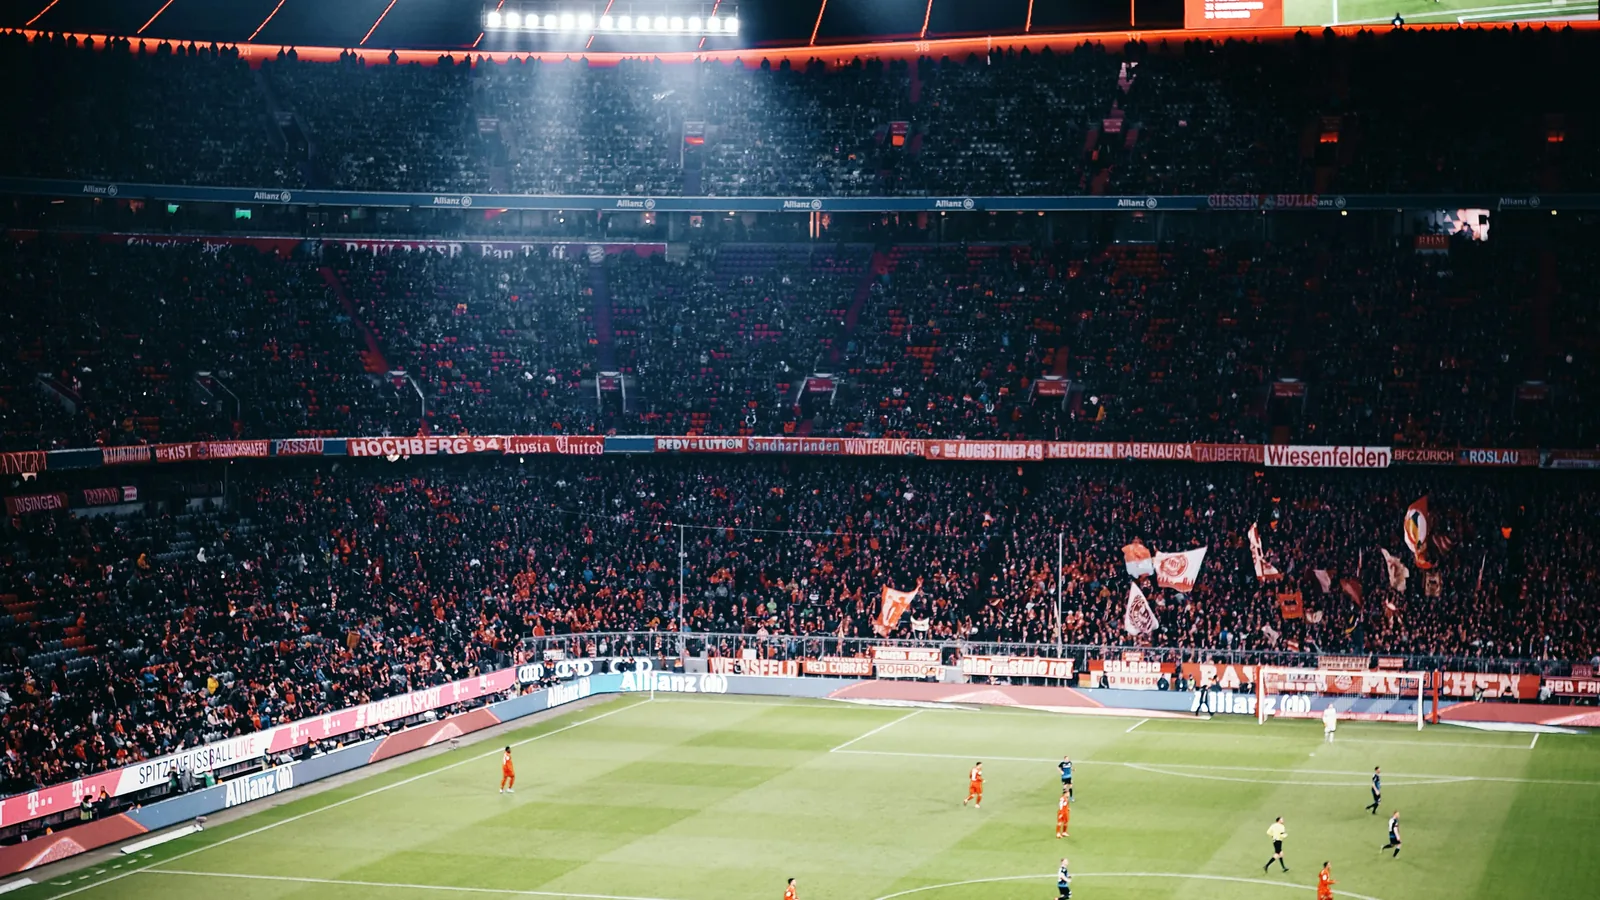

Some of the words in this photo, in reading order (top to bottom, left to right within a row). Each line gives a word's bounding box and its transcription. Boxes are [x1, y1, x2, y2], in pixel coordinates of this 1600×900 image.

[83, 185, 106, 194] Allianz
[254, 191, 279, 201] Allianz
[434, 196, 460, 206] Allianz
[617, 199, 643, 208] Allianz
[784, 200, 810, 209] Allianz
[936, 199, 962, 208] Allianz
[1117, 199, 1144, 208] Allianz
[1207, 194, 1260, 208] GIESSEN
[1276, 194, 1320, 208] BULLS
[1499, 197, 1527, 206] Allianz
[481, 244, 513, 259] Fan
[522, 245, 566, 259] Tff
[168, 444, 193, 460] KIST
[209, 441, 268, 457] FRIEDRICHSHAFEN
[276, 439, 324, 455] PASSAU
[555, 436, 604, 455] United
[748, 437, 840, 454] Sandharlanden
[958, 443, 1026, 459] AUGUSTINER
[1027, 444, 1043, 459] 49
[1048, 443, 1114, 458] MEUCHEN
[1117, 443, 1193, 460] RABENAU/SA
[1195, 446, 1263, 462] TAUBERTAL
[1267, 446, 1389, 467] Wiesenfelden
[1394, 450, 1415, 461] BFC
[15, 495, 62, 512] INSINGEN
[711, 657, 797, 677] WENSFELD
[806, 660, 827, 673] RED
[829, 661, 869, 675] COBRAS
[1048, 660, 1074, 677] rot
[621, 671, 697, 692] Allianz
[1546, 680, 1574, 693] RED
[547, 682, 580, 708] Allianz
[367, 696, 413, 727] MAGENTA
[413, 689, 441, 713] SPORT
[235, 738, 255, 759] LIVE
[226, 773, 277, 808] Allianz
